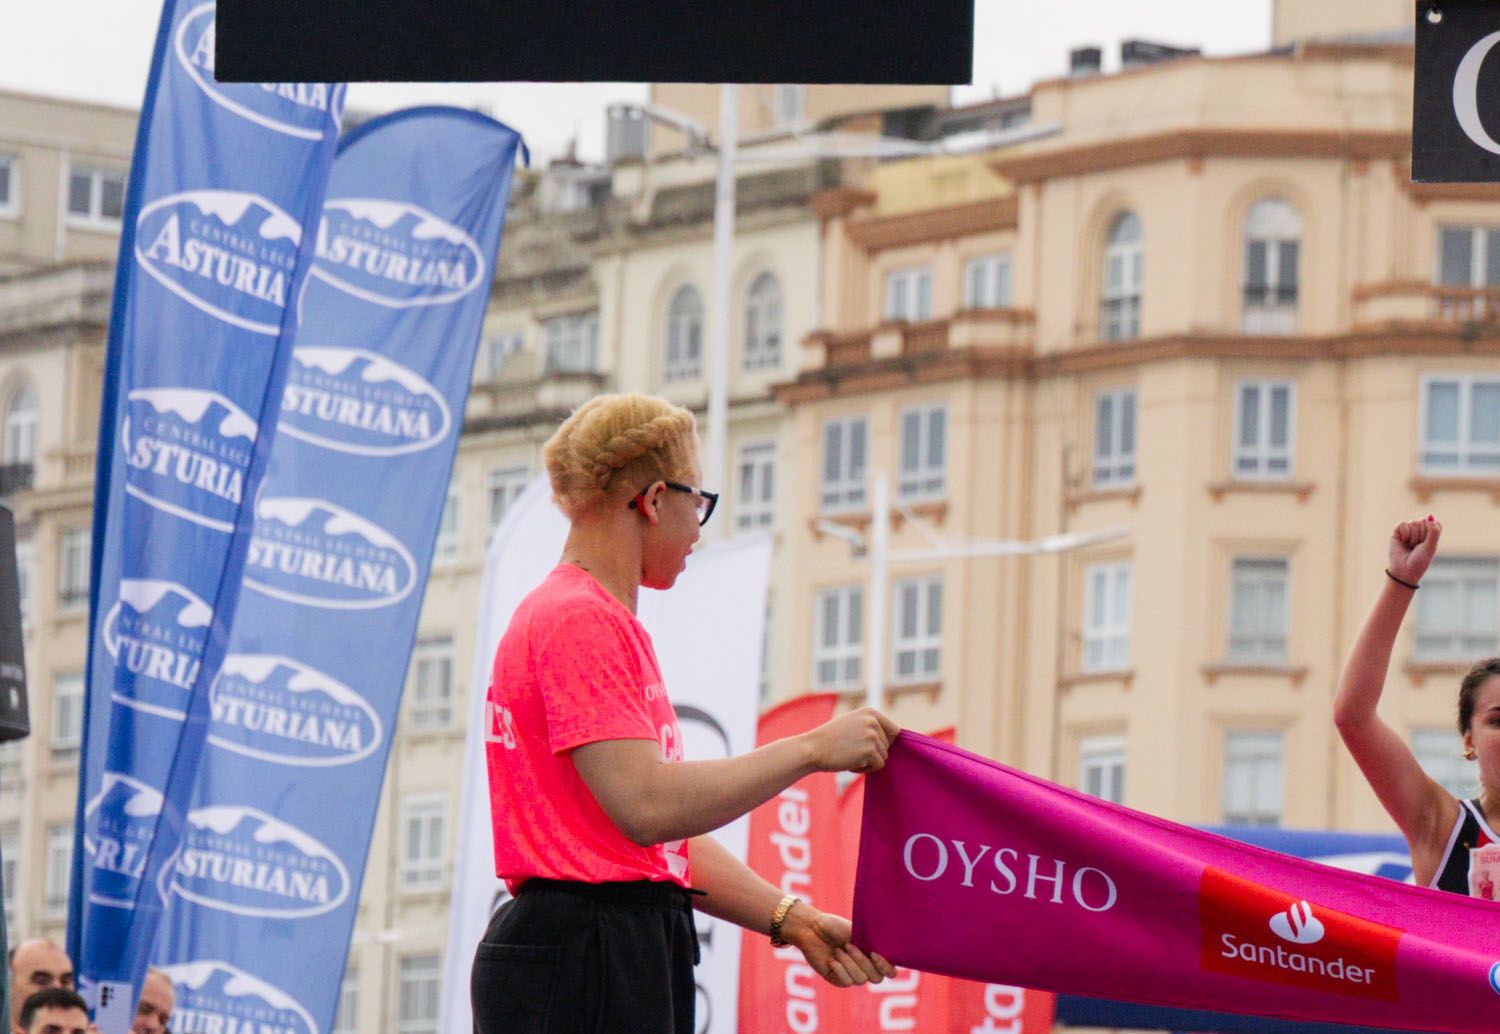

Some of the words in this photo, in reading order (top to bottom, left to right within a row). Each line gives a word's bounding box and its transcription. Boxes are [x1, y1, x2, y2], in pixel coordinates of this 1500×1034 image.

[178, 848, 330, 903] STURIANA
[903, 833, 1118, 912] OYSHO
[1221, 933, 1376, 985] Santander
